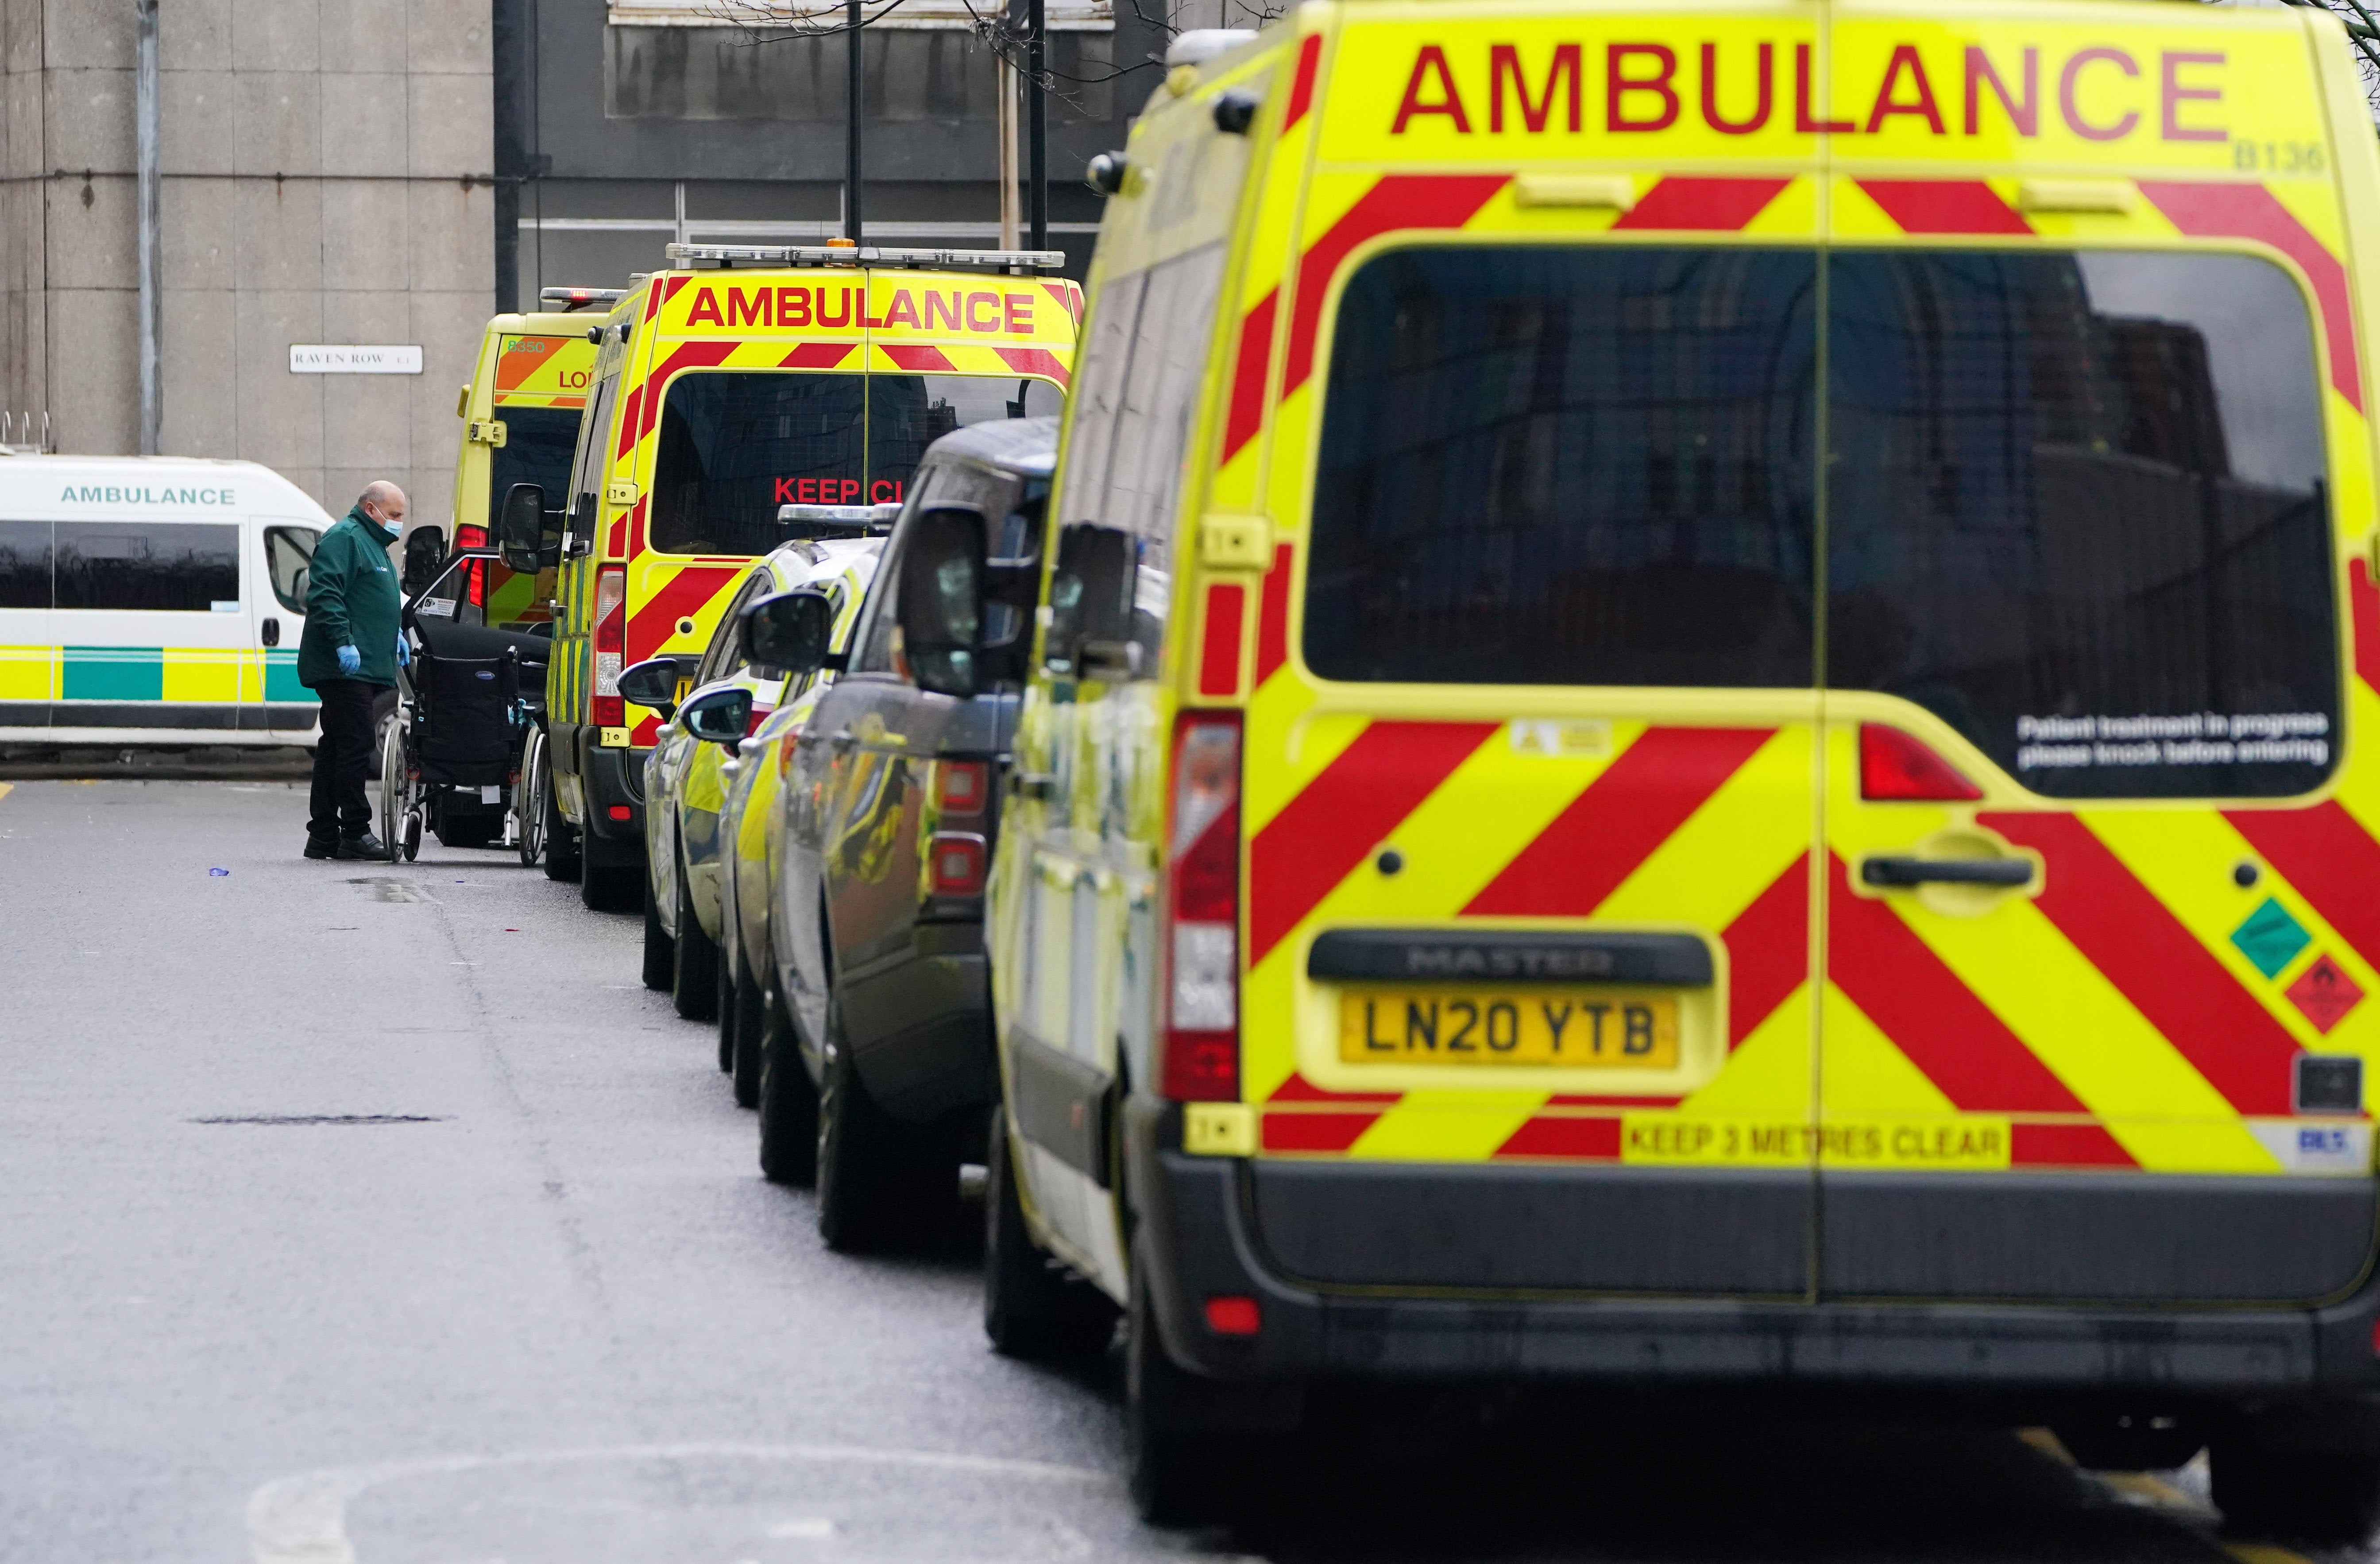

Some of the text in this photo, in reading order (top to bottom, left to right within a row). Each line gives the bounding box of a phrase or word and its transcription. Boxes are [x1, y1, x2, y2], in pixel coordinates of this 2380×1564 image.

[1391, 43, 2228, 142] AMBULANCE
[686, 287, 1034, 334] AMBULANCE
[295, 354, 345, 363] RAVEN
[352, 354, 384, 363] ROW
[508, 341, 545, 353] 8350
[560, 371, 593, 388] LO
[61, 487, 235, 505] AMBULANCE
[775, 478, 860, 503] KEEP
[2017, 711, 2329, 741] Patient treatment in progress
[2017, 738, 2329, 772] please knock before entering
[1407, 947, 1614, 974] MASTER
[1365, 1001, 1656, 1056] LN20 YTB
[1630, 1123, 2001, 1159] KEEP 3 METRES CLEAR
